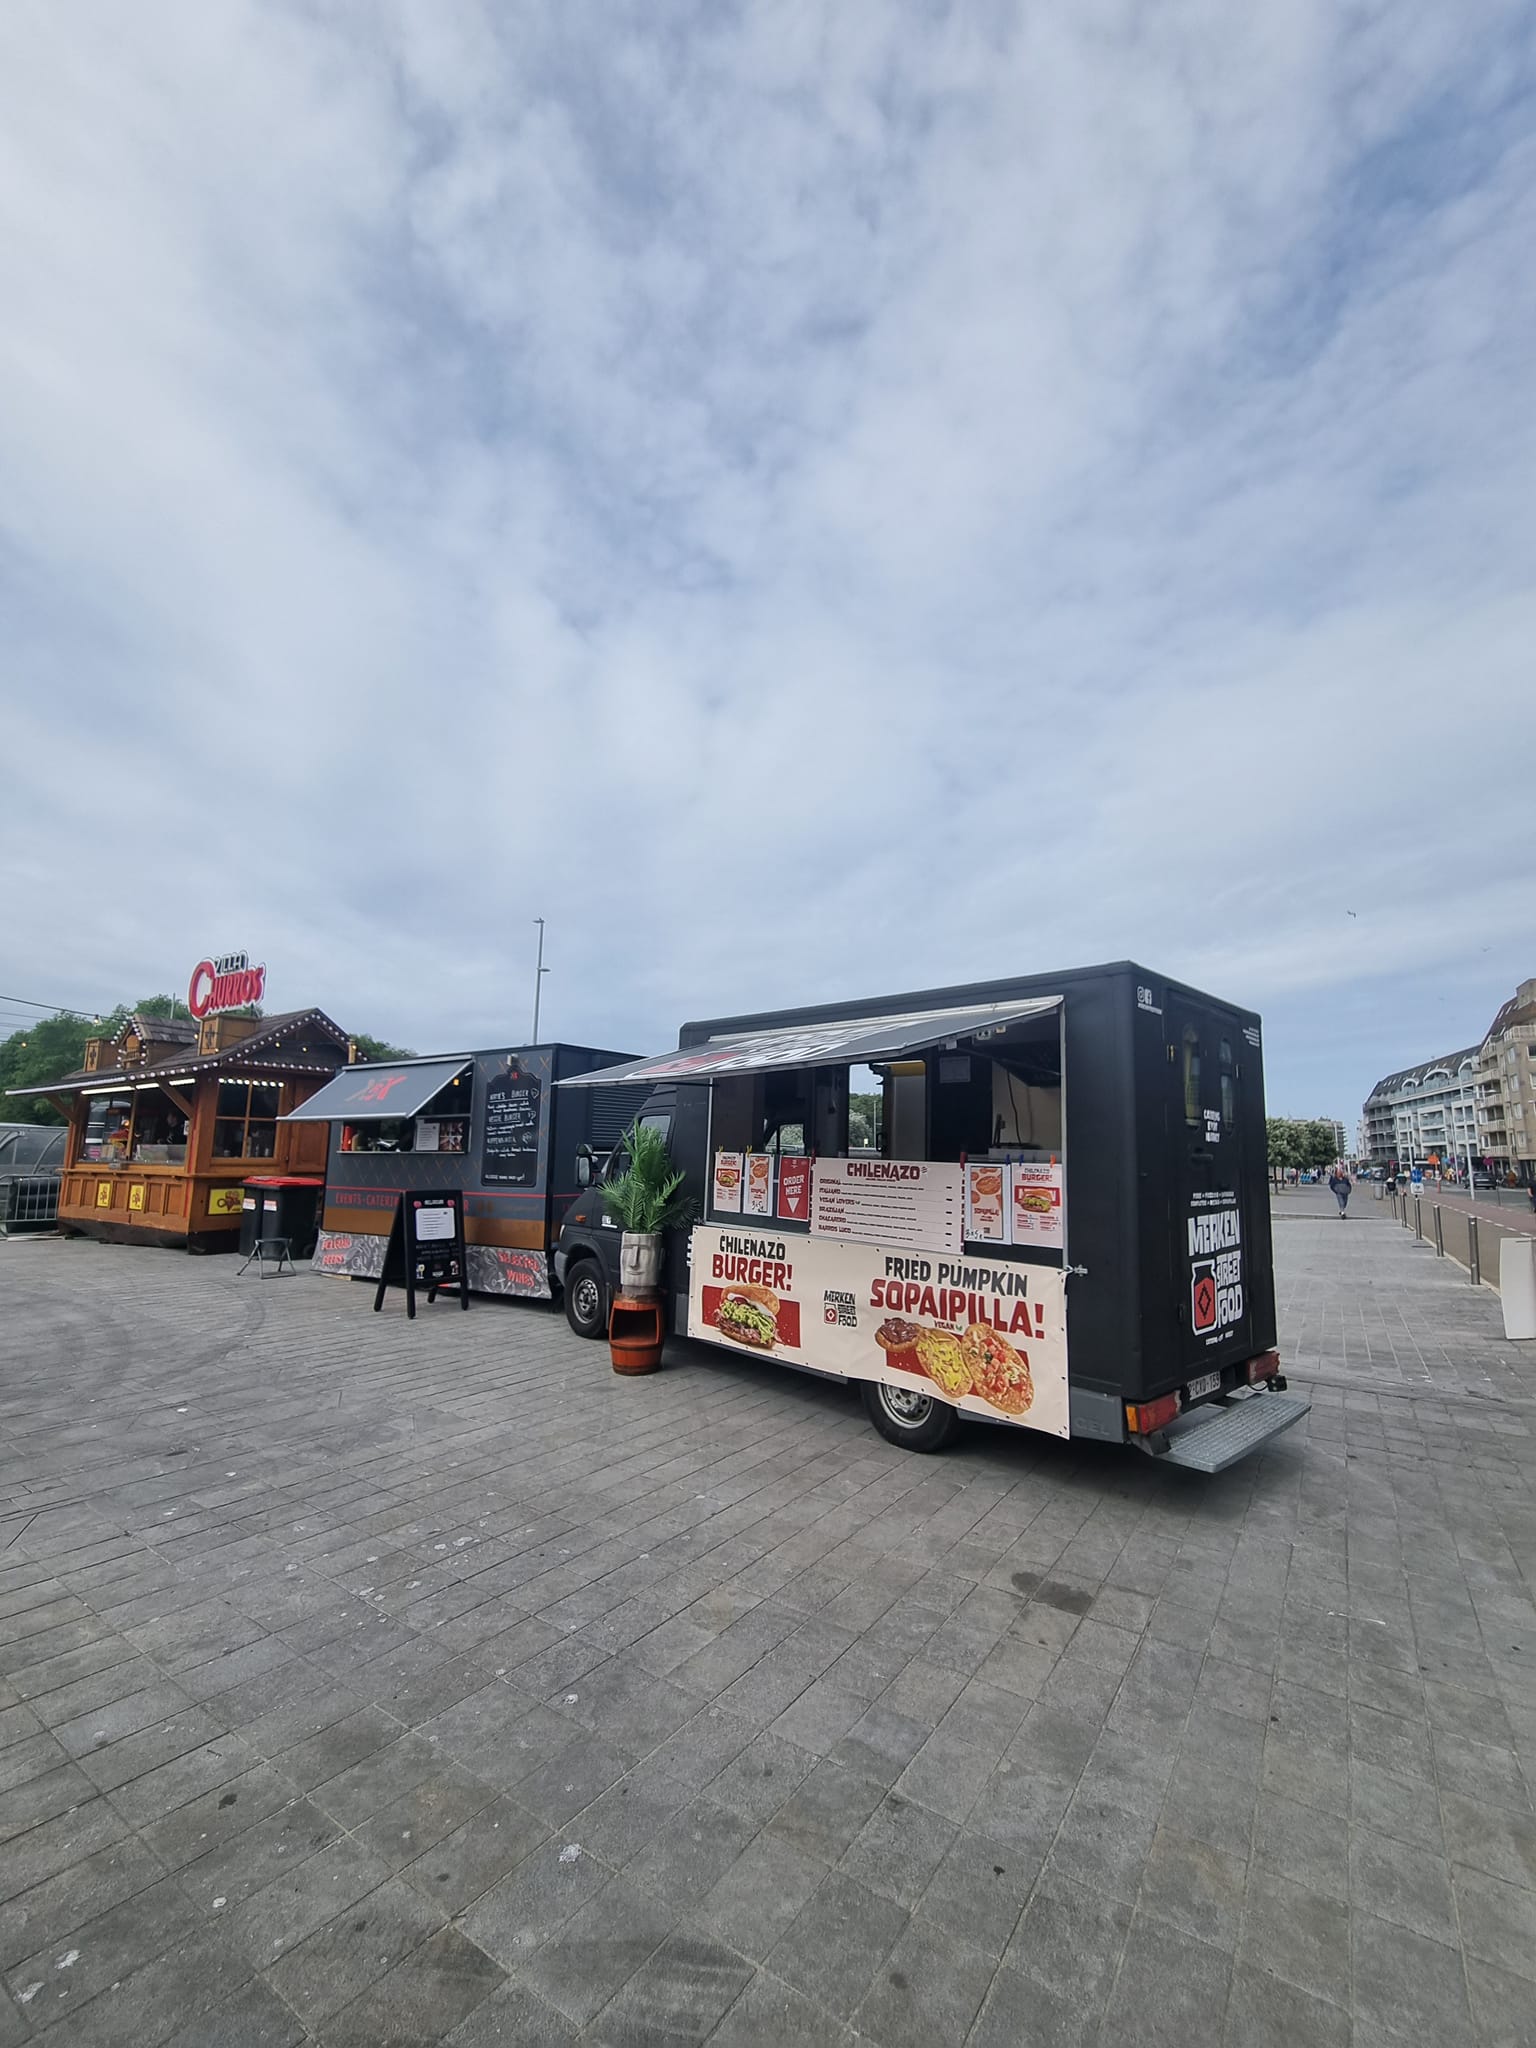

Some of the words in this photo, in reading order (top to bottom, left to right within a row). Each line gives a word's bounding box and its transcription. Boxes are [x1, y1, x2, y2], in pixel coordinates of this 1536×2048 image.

[188, 960, 264, 1018] CHURROS
[783, 1174, 805, 1187] ORDER
[846, 1162, 920, 1181] CHILENAZO
[785, 1185, 802, 1196] HERE
[819, 1196, 835, 1204] VEGAN
[719, 1235, 787, 1260] CHILENAZO
[1187, 1208, 1241, 1257] MERKEN
[712, 1253, 793, 1291] BURGER!
[885, 1256, 932, 1282] FRIED
[938, 1263, 1029, 1298] PUMPKIN
[1216, 1250, 1241, 1289] STREET
[823, 1290, 856, 1305] MERKEN
[870, 1278, 1046, 1339] SOPAIPILLA!
[1217, 1284, 1243, 1329] FOOD
[934, 1320, 955, 1331] VEGAN
